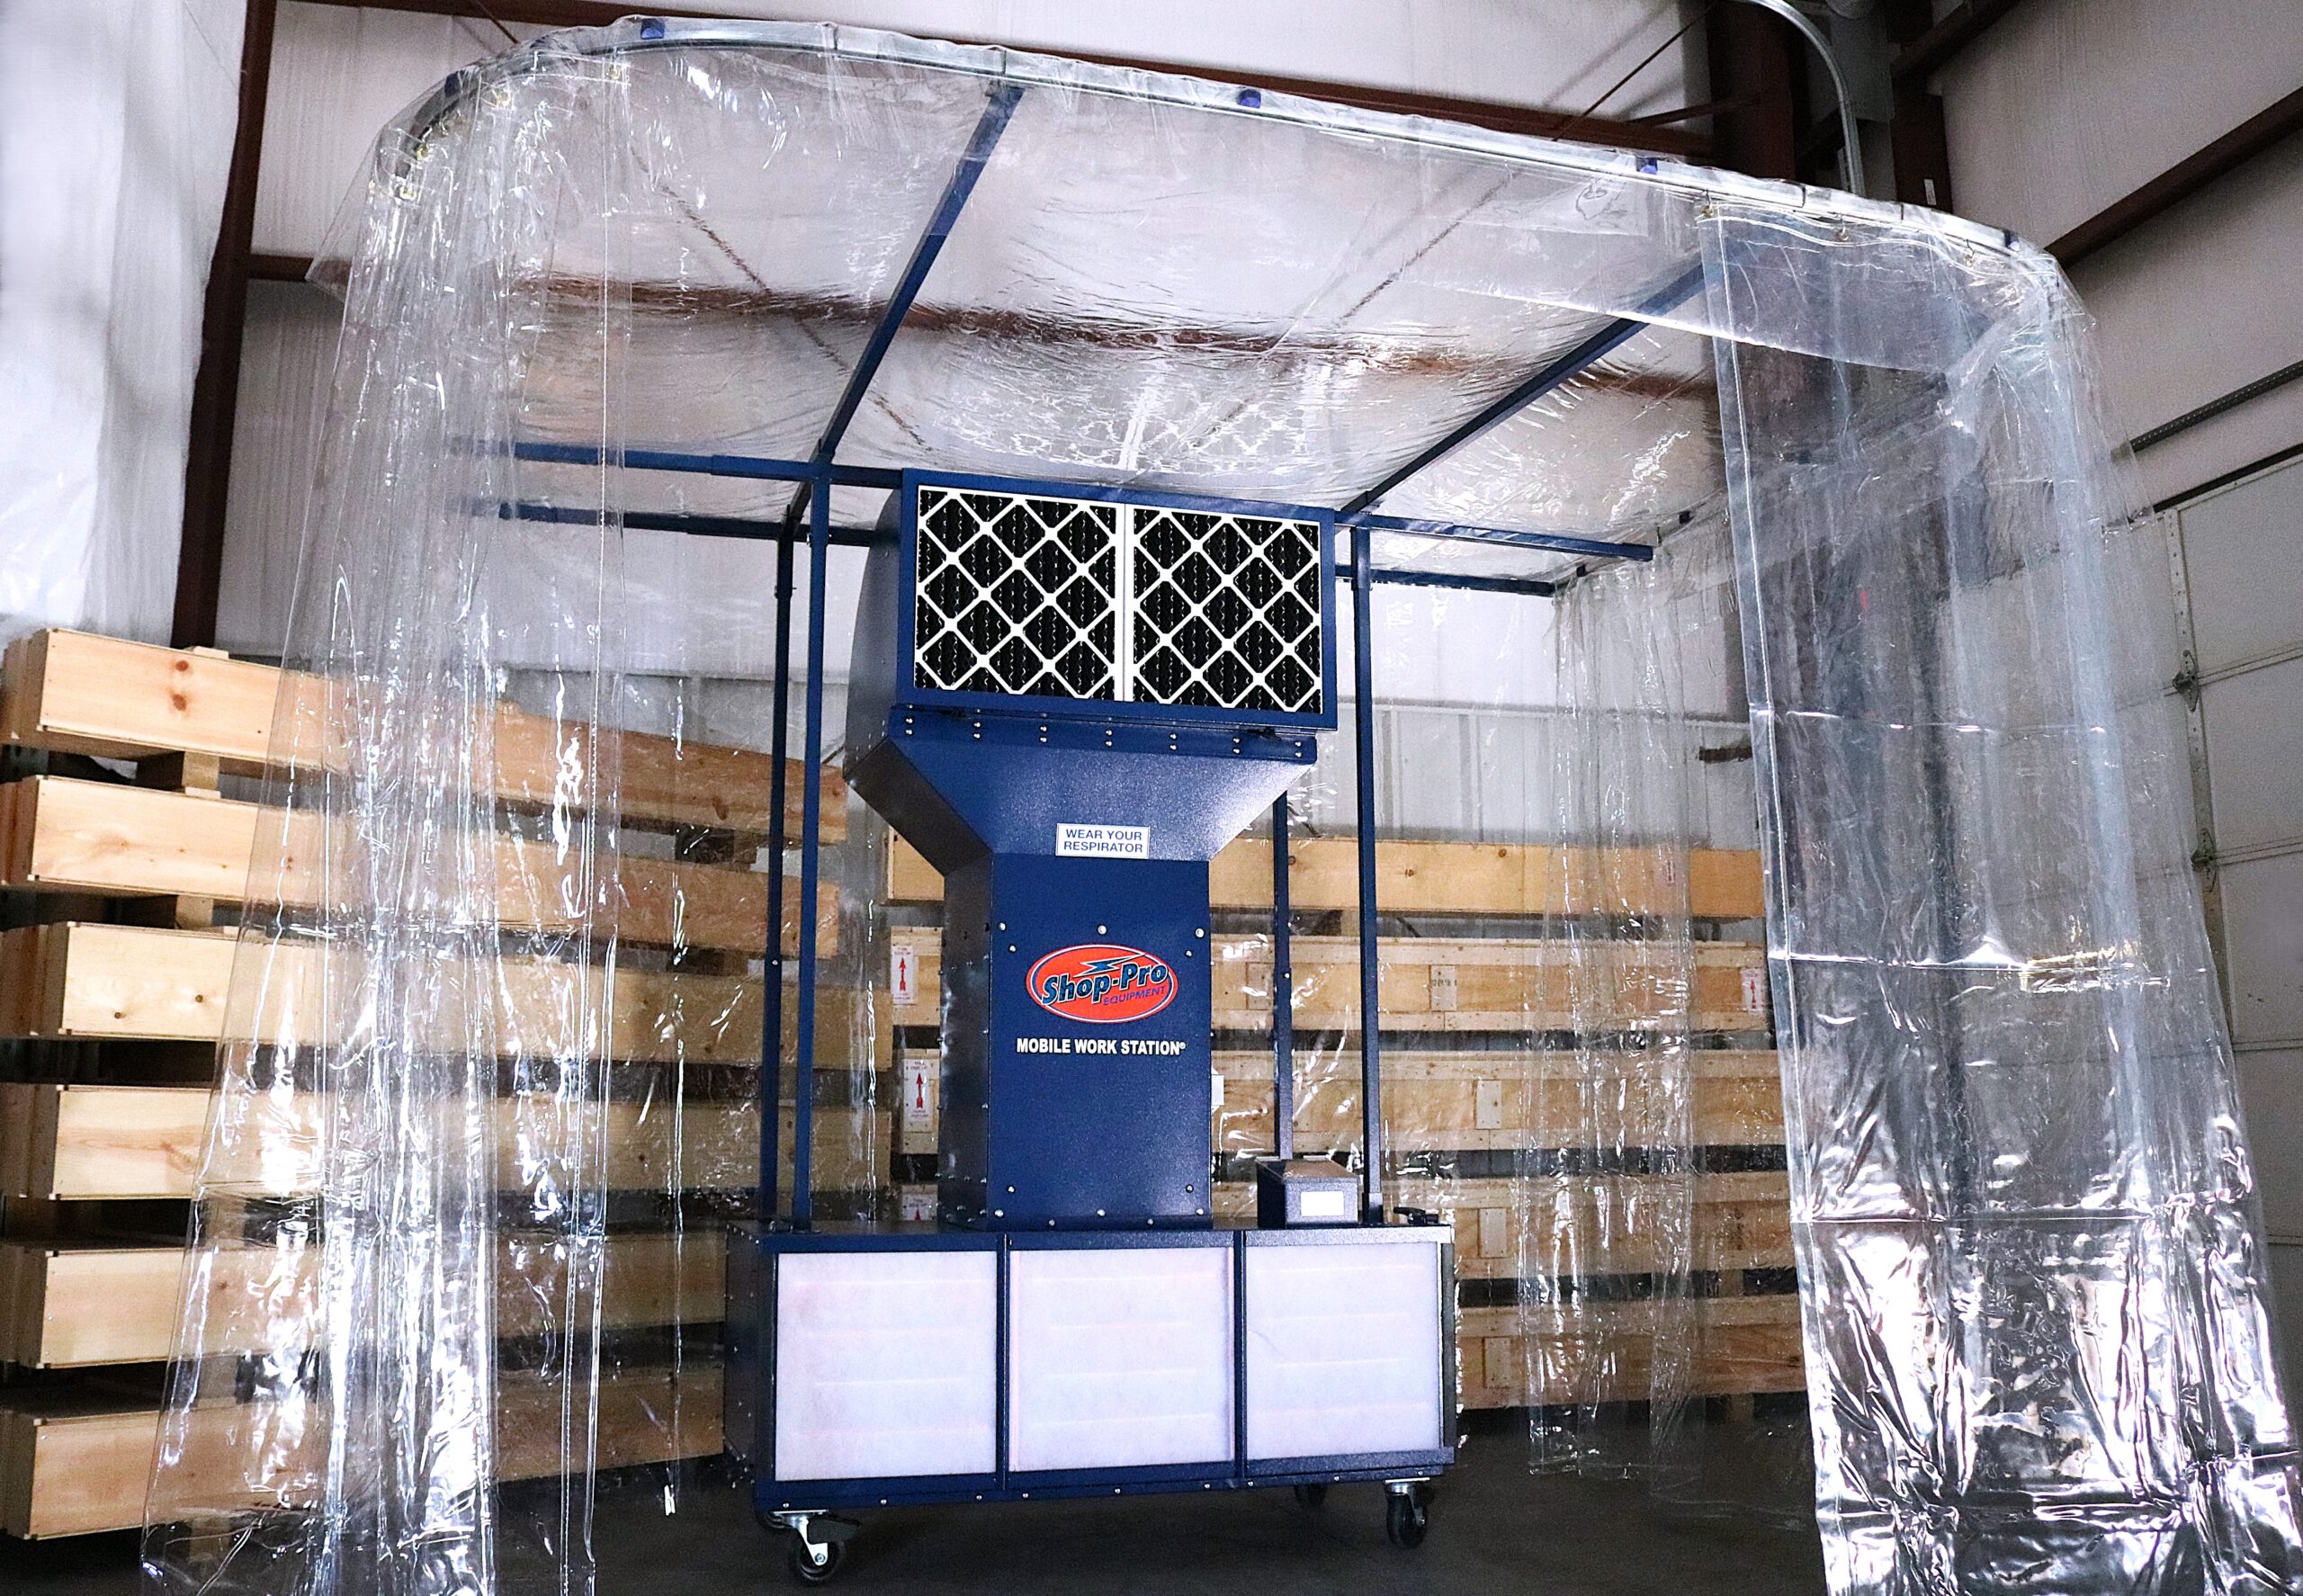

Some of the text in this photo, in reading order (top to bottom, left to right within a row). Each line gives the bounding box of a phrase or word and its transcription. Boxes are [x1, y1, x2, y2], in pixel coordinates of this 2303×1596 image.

[1066, 829, 1143, 841] WEAR YOUR
[1063, 840, 1143, 853] RESPIRATOR
[1042, 962, 1169, 1006] Shop-Pro
[1103, 985, 1167, 1006] EQUIPMENT
[1017, 1037, 1071, 1054] MOBILE
[1074, 1038, 1117, 1054] WORK
